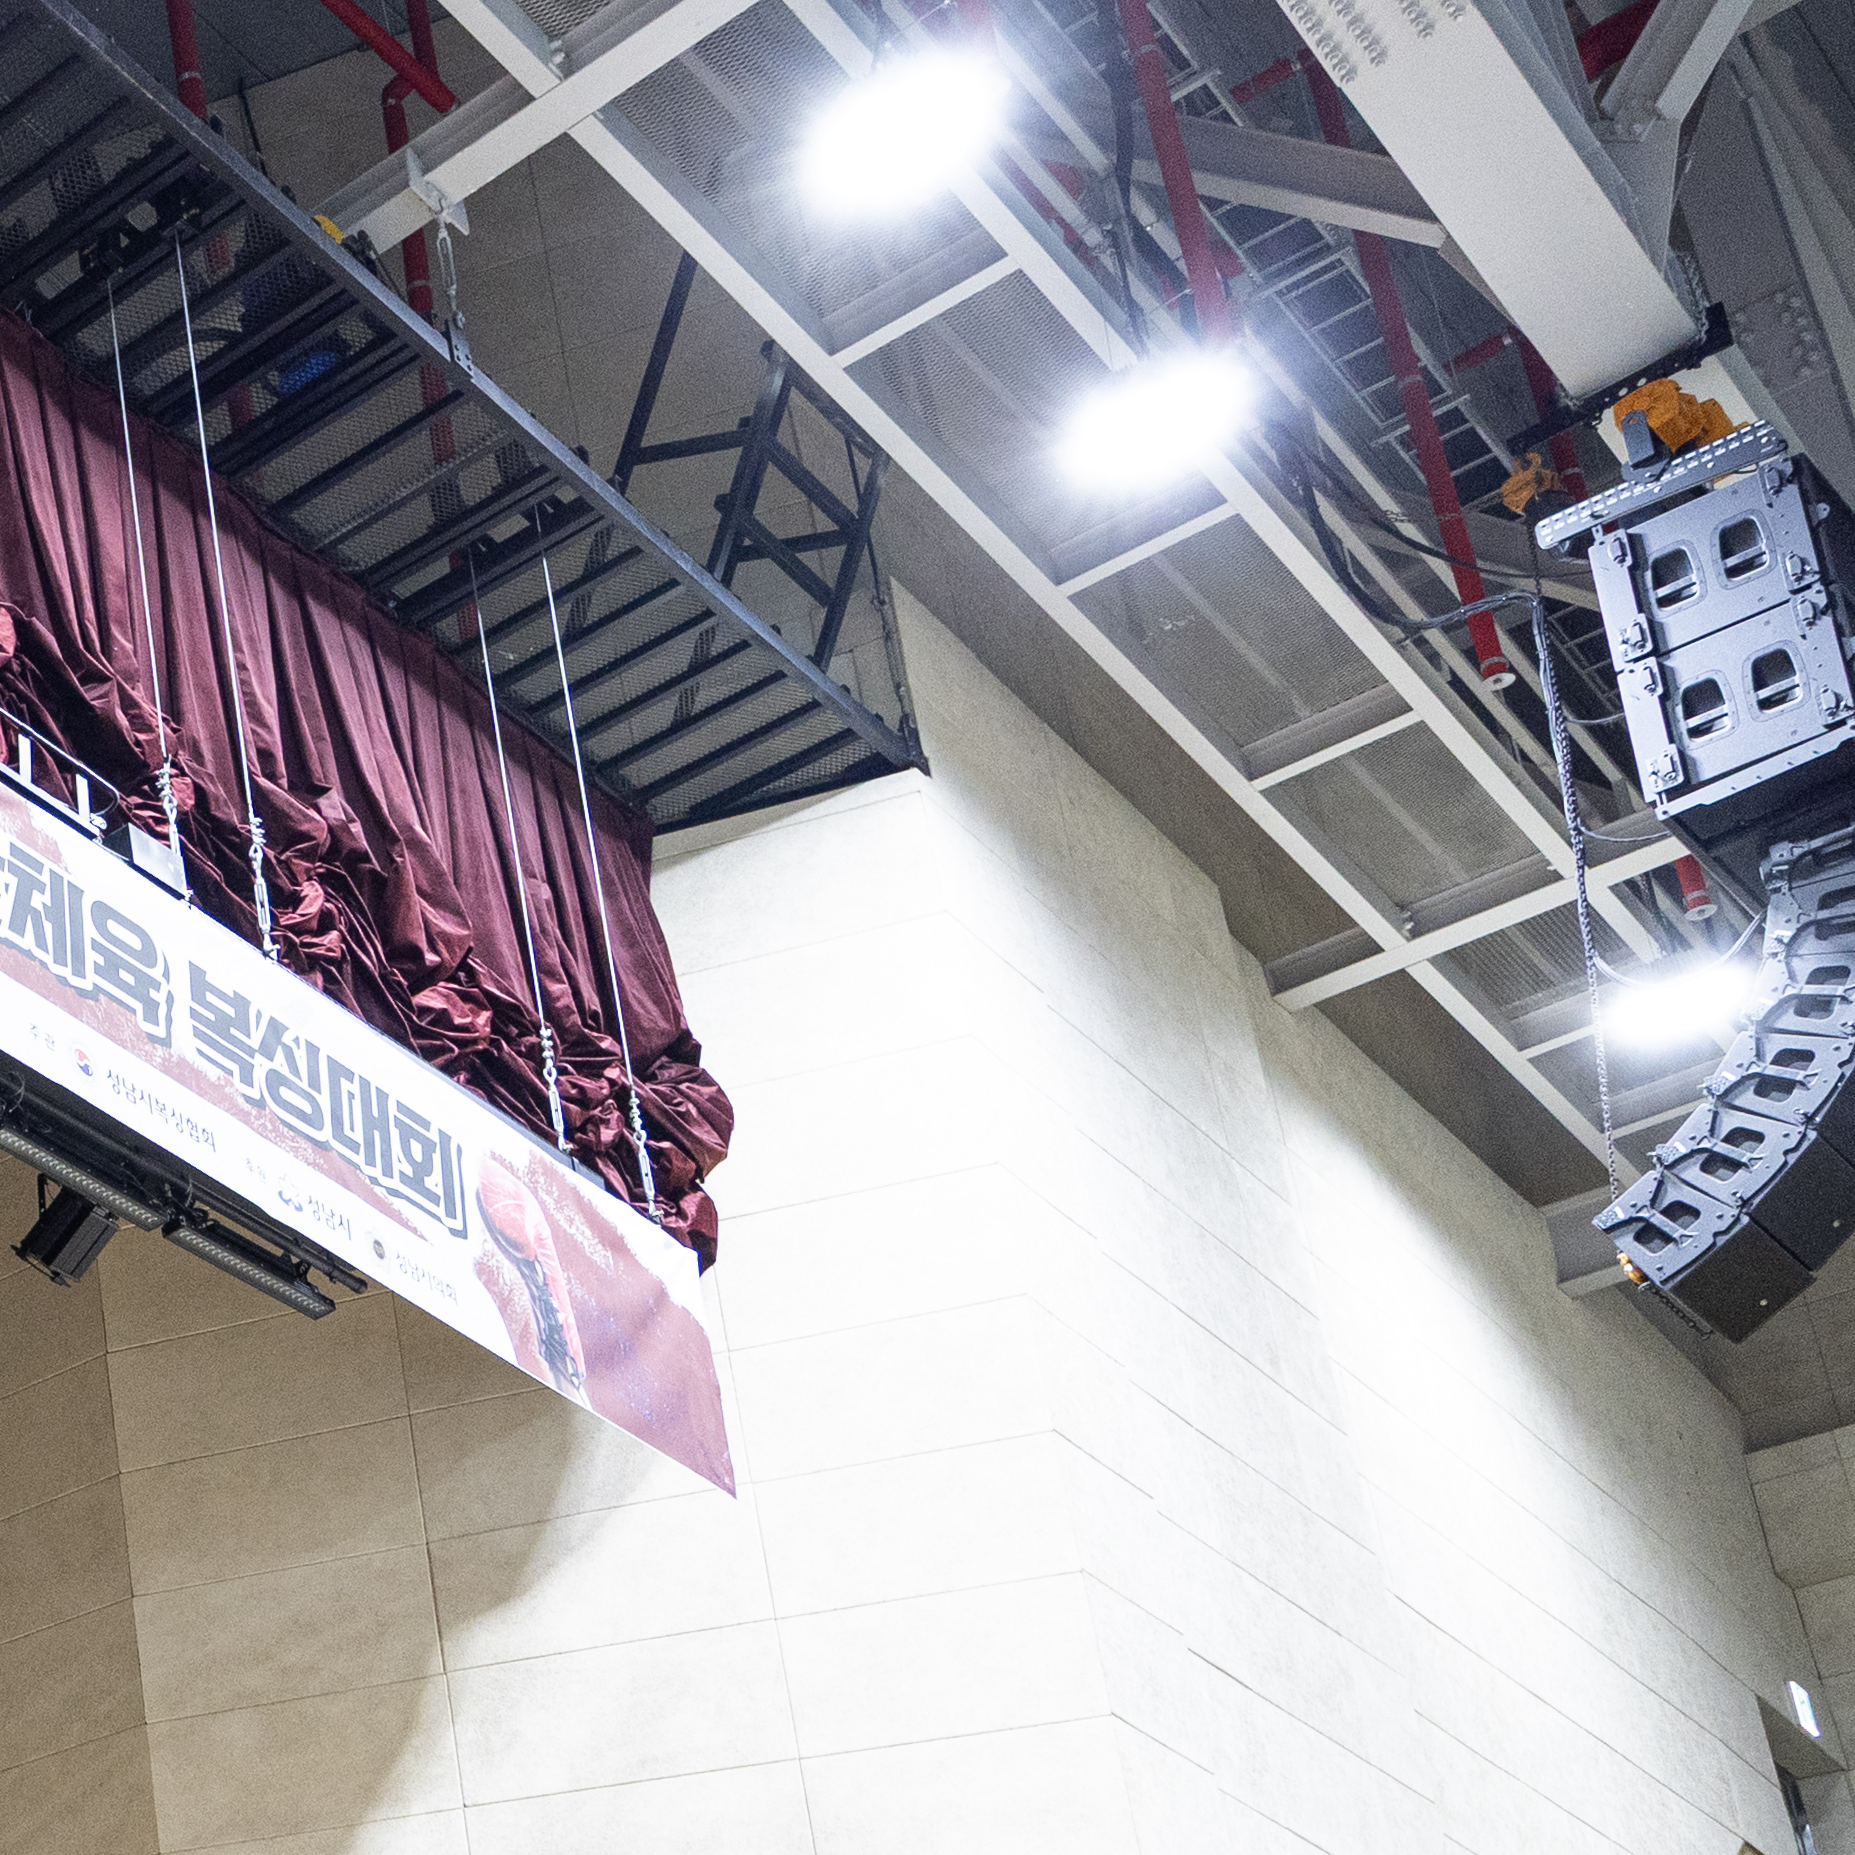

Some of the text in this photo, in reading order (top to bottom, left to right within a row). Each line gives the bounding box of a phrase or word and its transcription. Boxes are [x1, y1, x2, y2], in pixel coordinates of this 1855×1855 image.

[105, 1068, 217, 1153] 성남시복싱협회
[190, 966, 461, 1223] 복싱대회
[307, 1194, 353, 1242] 성남시
[395, 1251, 459, 1306] 성남시의회
